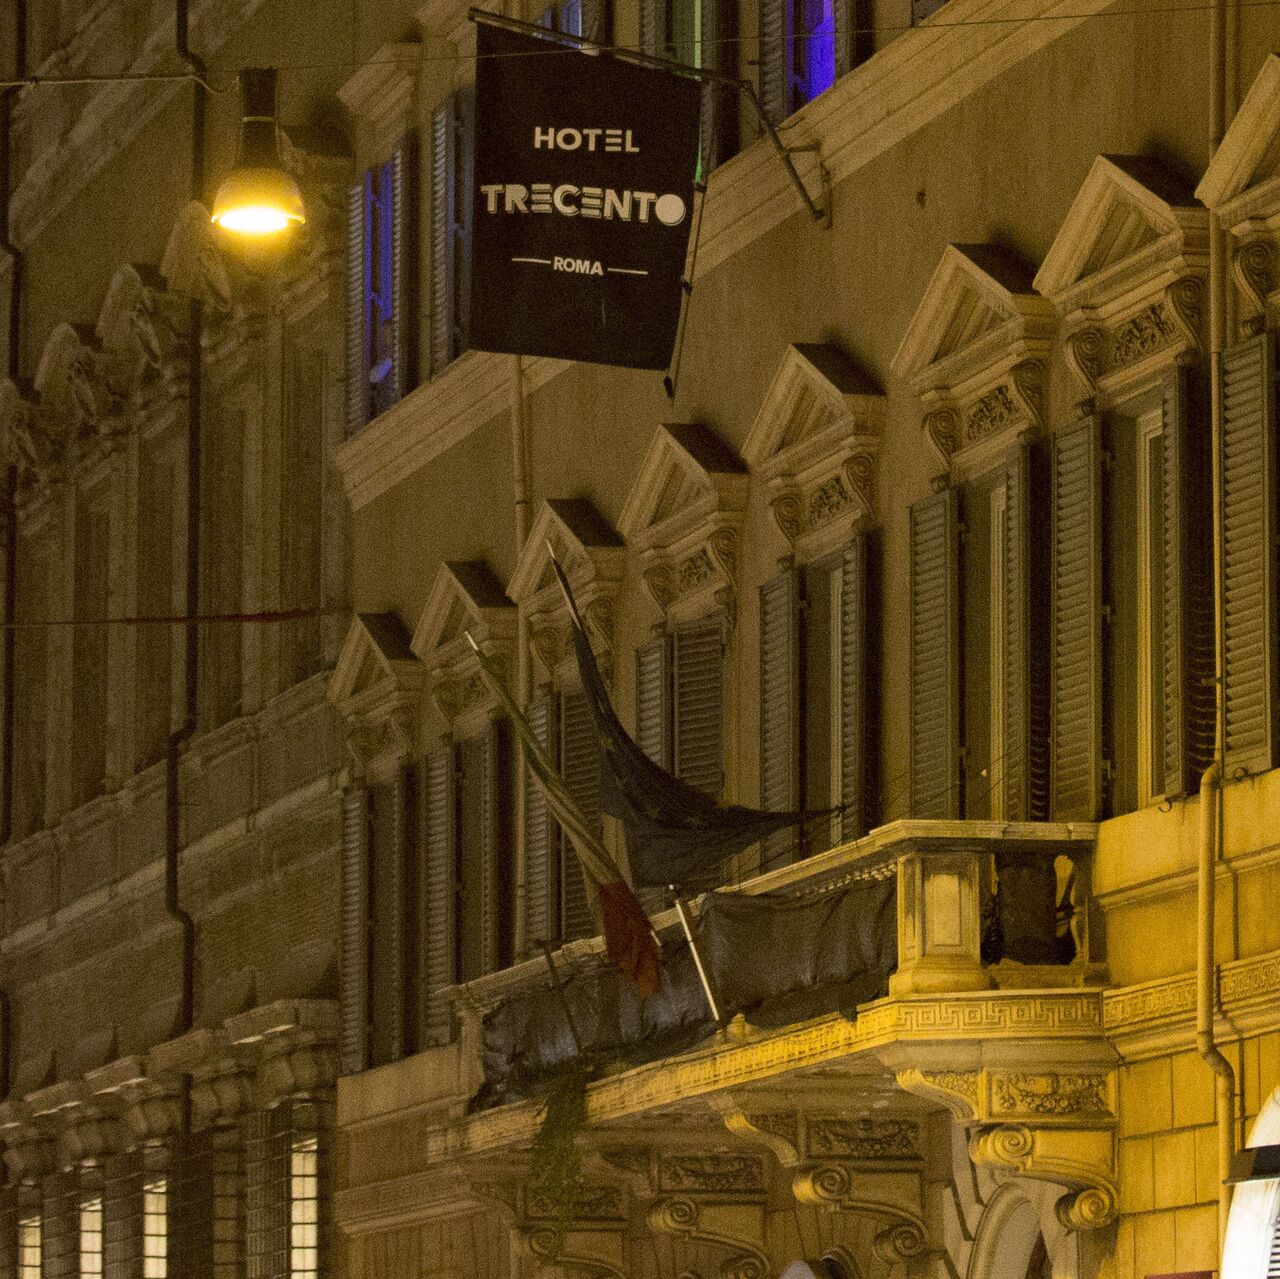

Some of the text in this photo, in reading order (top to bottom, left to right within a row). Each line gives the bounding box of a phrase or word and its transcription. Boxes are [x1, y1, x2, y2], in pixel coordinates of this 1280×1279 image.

[534, 127, 640, 153] HOTEL
[481, 184, 686, 226] TRECENTO
[553, 256, 604, 276] ROMA
